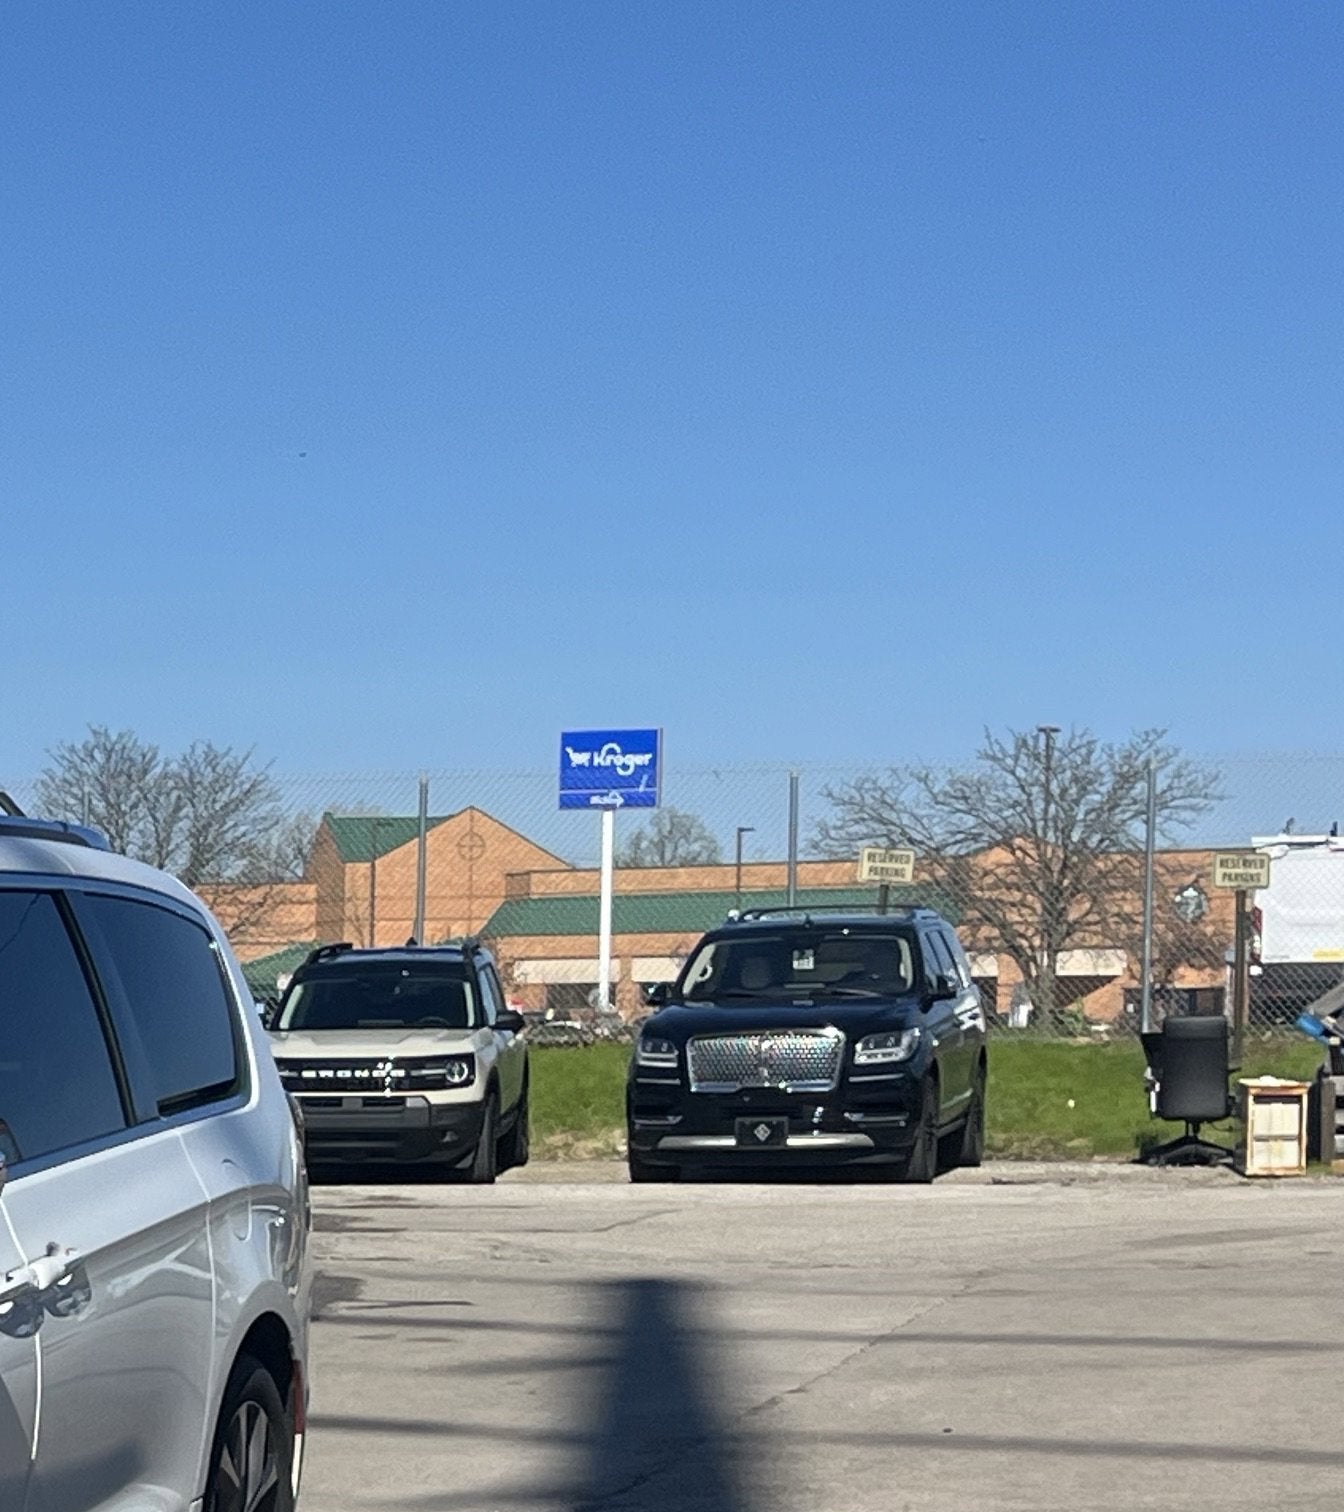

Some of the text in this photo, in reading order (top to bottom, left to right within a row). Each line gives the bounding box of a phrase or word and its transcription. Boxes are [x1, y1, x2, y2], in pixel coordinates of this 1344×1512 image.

[592, 742, 653, 776] Kroger
[867, 852, 911, 864] RESERVED
[1219, 858, 1265, 870] RESERVED
[868, 865, 906, 879] PARKING
[1222, 871, 1263, 883] PARKING
[301, 1068, 406, 1078] BRONCO
